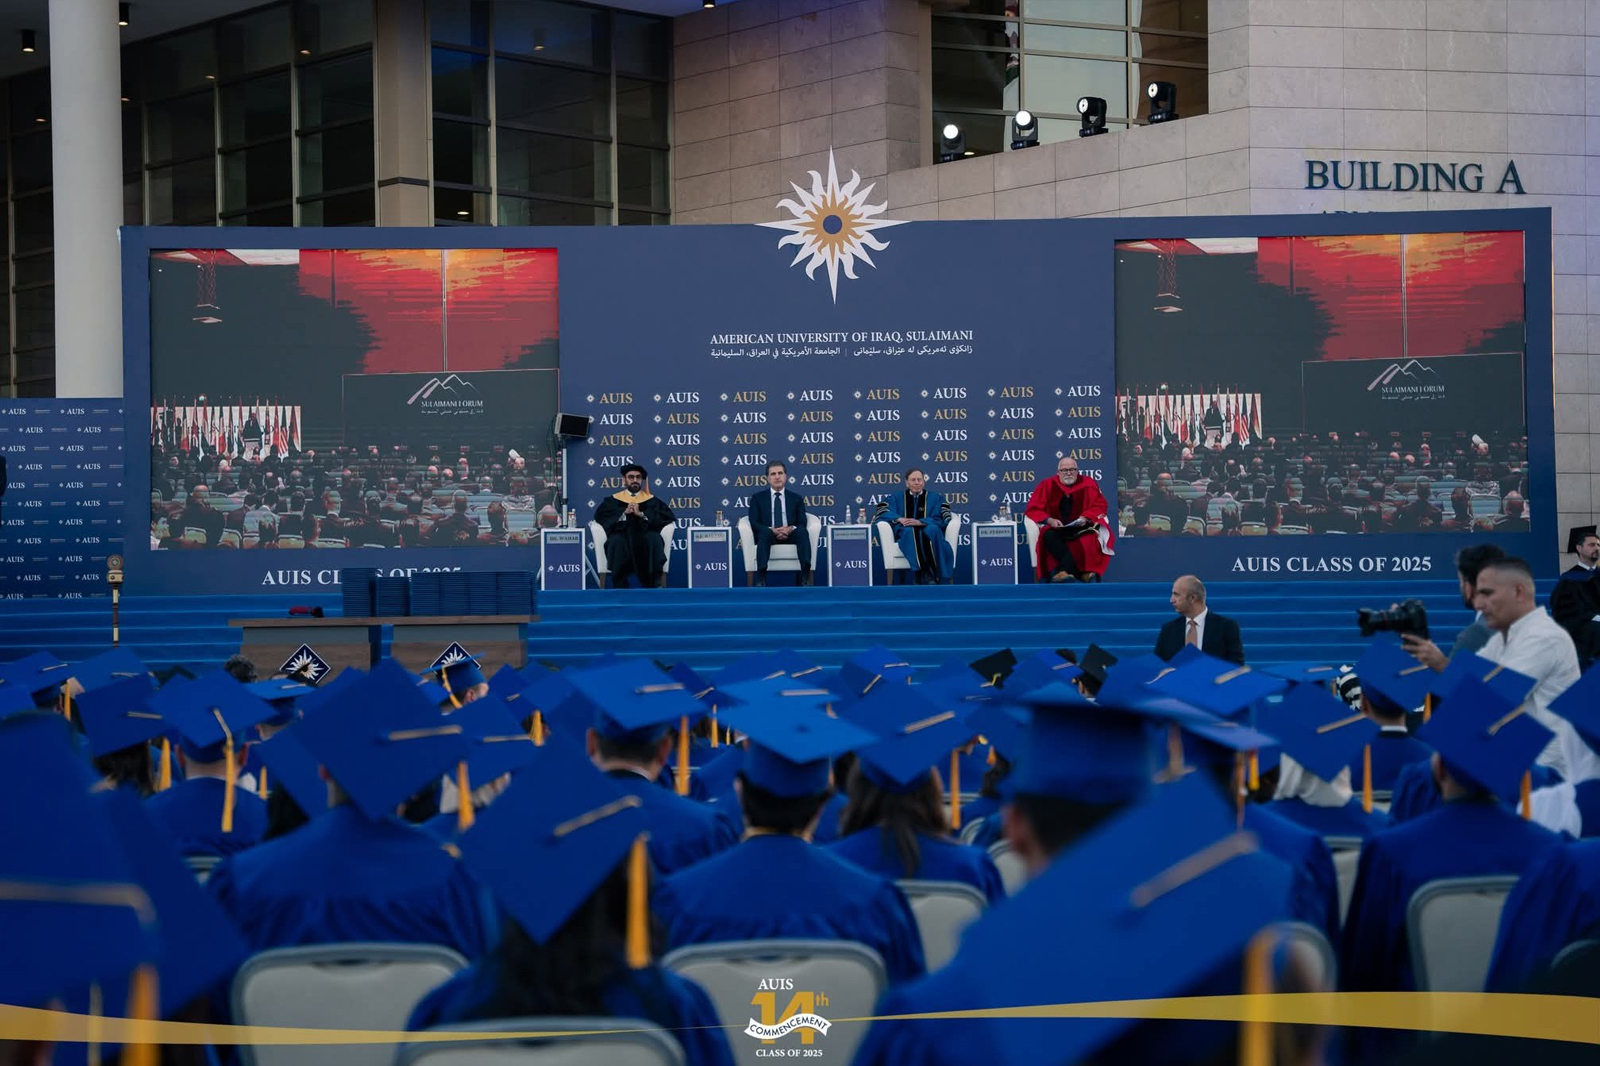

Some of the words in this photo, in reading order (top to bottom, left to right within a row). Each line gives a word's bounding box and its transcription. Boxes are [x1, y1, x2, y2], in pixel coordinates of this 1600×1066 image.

[1305, 160, 1485, 193] BUILDING
[1496, 159, 1527, 195] A
[710, 334, 774, 345] AMERICAN
[777, 332, 849, 344] UNIVERSITY
[852, 331, 868, 342] OF
[871, 331, 904, 343] IRAQ,
[906, 330, 973, 341] SULAIMANI
[733, 391, 767, 402] AUIS
[800, 390, 834, 401] AUIS
[867, 389, 900, 399] AUIS
[934, 388, 967, 398] AUIS
[1001, 387, 1034, 397] AUIS
[1068, 386, 1101, 396] AUIS
[600, 393, 633, 404] AUIS
[667, 392, 700, 403] AUIS
[734, 412, 767, 423] AUIS
[801, 411, 834, 422] AUIS
[867, 410, 901, 421] AUIS
[934, 409, 967, 419] AUIS
[1001, 408, 1035, 418] AUIS
[1068, 407, 1102, 417] AUIS
[600, 414, 634, 424] AUIS
[667, 413, 700, 424] AUIS
[734, 433, 768, 444] AUIS
[801, 432, 834, 443] AUIS
[868, 431, 901, 442] AUIS
[934, 430, 968, 440] AUIS
[1001, 429, 1035, 439] AUIS
[1068, 428, 1102, 438] AUIS
[600, 435, 634, 446] AUIS
[667, 434, 701, 445] AUIS
[734, 454, 767, 465] AUIS
[801, 453, 834, 464] AUIS
[868, 452, 901, 463] AUIS
[935, 451, 968, 462] AUIS
[1002, 450, 1035, 461] AUIS
[1070, 449, 1102, 460] AUIS
[600, 456, 634, 467] AUIS
[667, 455, 701, 466] AUIS
[667, 476, 701, 487] AUIS
[734, 475, 768, 486] AUIS
[801, 474, 835, 485] AUIS
[868, 473, 902, 484] AUIS
[935, 472, 969, 483] AUIS
[1002, 471, 1035, 482] AUIS
[669, 498, 700, 508] AUIS
[803, 495, 835, 506] AUIS
[944, 493, 969, 504] UIS
[704, 562, 727, 571] AUIS
[844, 560, 867, 569] AUIS
[989, 558, 1013, 566] AUIS
[1232, 557, 1281, 572] AUIS
[1286, 557, 1352, 572] CLASS
[1359, 557, 1387, 572] OF
[1392, 556, 1431, 571] 2025
[557, 564, 580, 573] AUIS
[262, 570, 311, 585] AUIS
